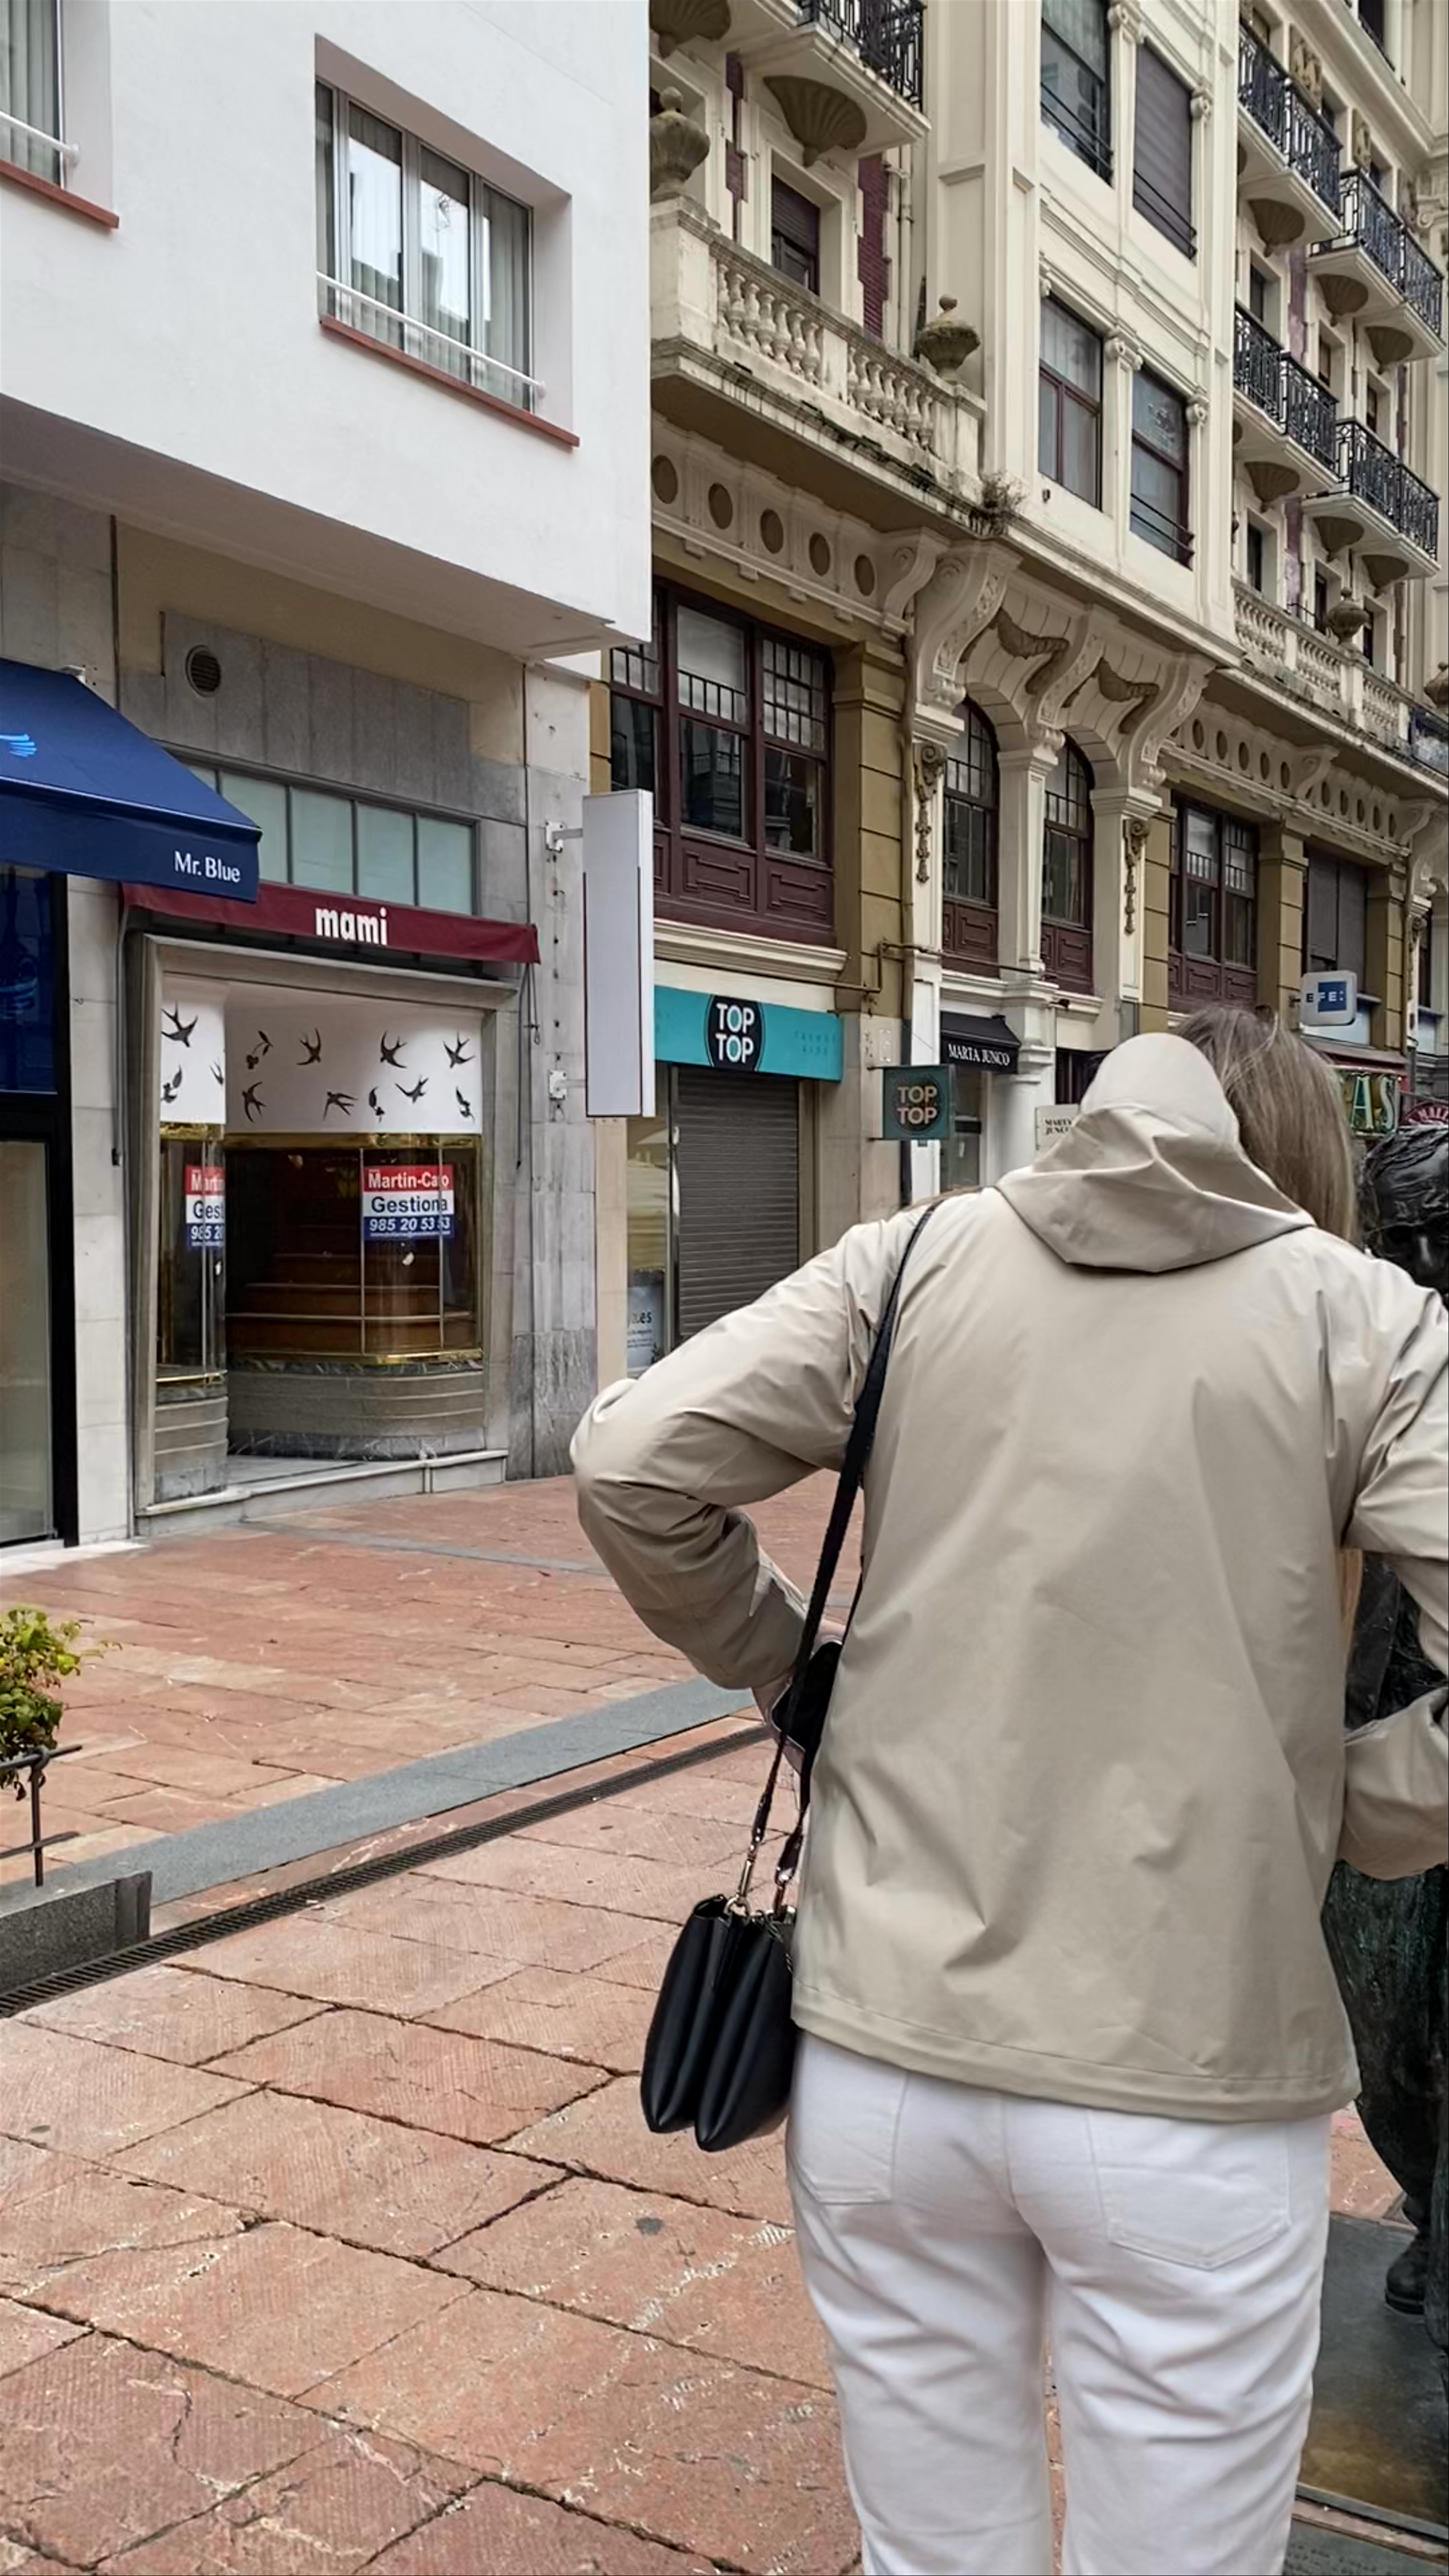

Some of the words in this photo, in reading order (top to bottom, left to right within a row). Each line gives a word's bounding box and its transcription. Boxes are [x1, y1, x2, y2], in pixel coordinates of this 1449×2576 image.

[175, 850, 202, 876] Mr.
[205, 857, 240, 883] Blue
[315, 907, 387, 946] mami
[716, 1003, 755, 1033] TOP
[715, 1033, 754, 1064] TOP
[948, 1043, 980, 1062] MARTA
[981, 1049, 1010, 1066] JUNCO
[898, 1086, 937, 1103] TOP
[897, 1107, 937, 1124] TOP
[368, 1171, 449, 1188] Martin-Cao
[371, 1195, 447, 1213] Gestiona
[369, 1219, 396, 1231] 985
[400, 1218, 417, 1231] 20
[420, 1217, 435, 1230] 53
